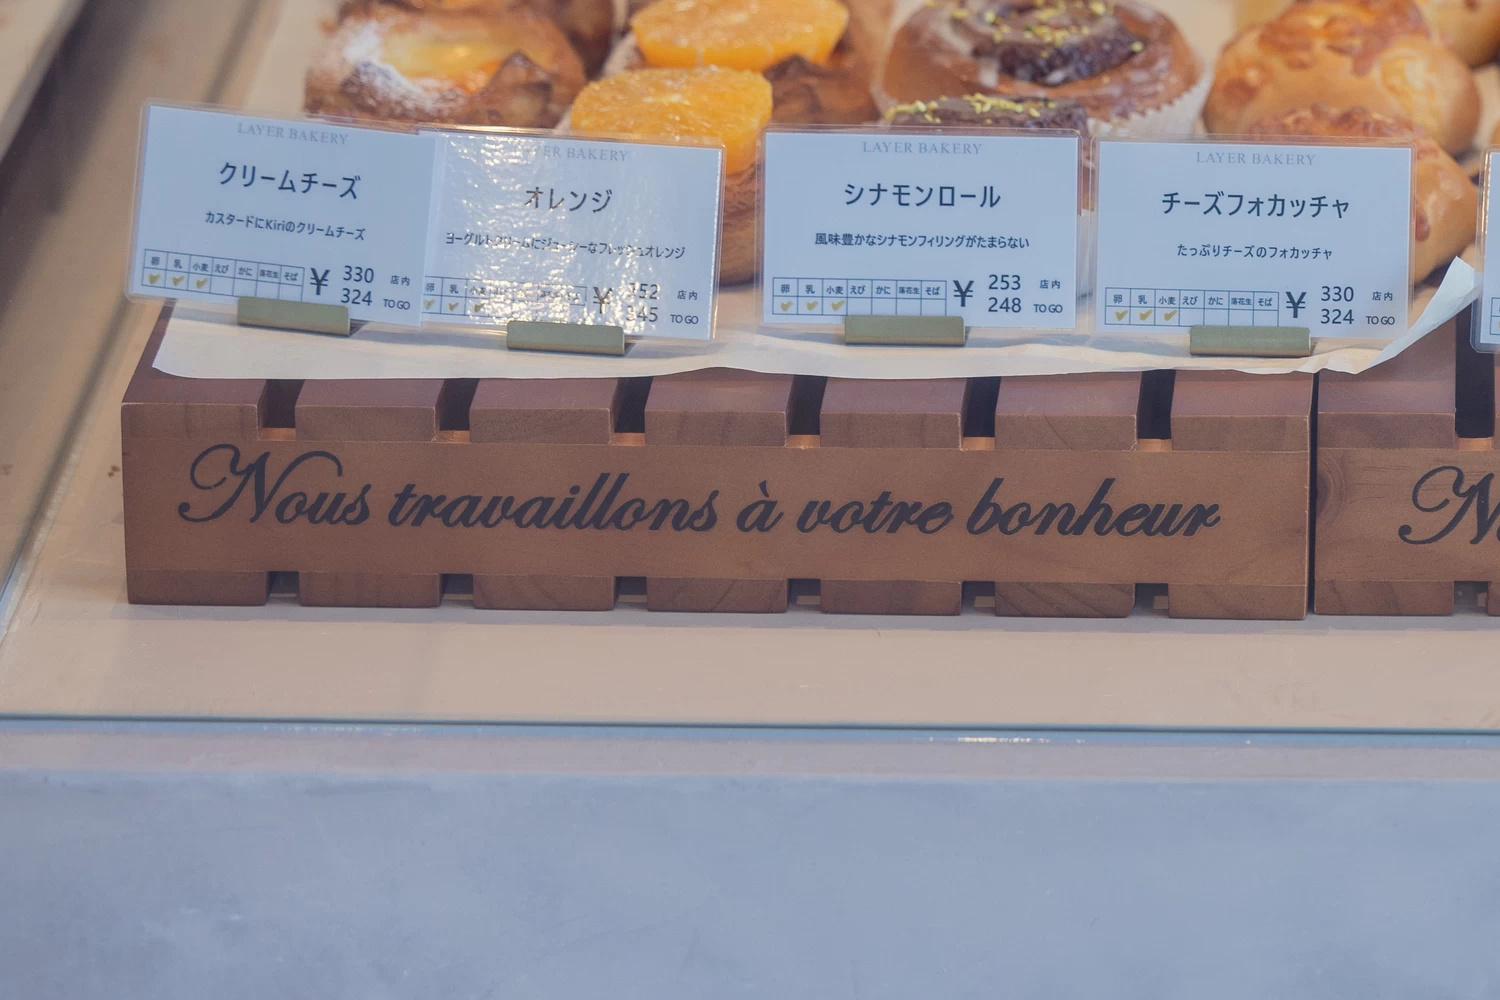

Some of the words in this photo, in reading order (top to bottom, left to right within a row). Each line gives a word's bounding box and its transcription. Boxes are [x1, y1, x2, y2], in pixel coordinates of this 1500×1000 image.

[237, 122, 285, 139] LAYER
[289, 128, 349, 146] BAKERY
[567, 147, 629, 161] BAKERY
[863, 141, 913, 154] LAYER
[918, 142, 983, 155] BAKERY
[1196, 152, 1246, 164] LAYER
[1252, 153, 1316, 166] BAKERY
[219, 161, 362, 200] クリームチーズ
[525, 186, 613, 213] オレンジ
[844, 182, 1001, 208] シナモンロール
[1162, 191, 1349, 219] チーズフォカッチャ
[205, 211, 366, 241] カスタードにKiriのクリームチーズ
[814, 232, 1030, 249] 風味豊かなシナモンフィリングがたまらない
[1177, 243, 1333, 261] たっぷりチーズのフォカッチャ
[342, 266, 375, 284] 330
[988, 274, 1021, 290] 253
[340, 288, 374, 307] 324
[1320, 286, 1355, 302] 330
[988, 297, 1021, 313] 248
[1320, 309, 1355, 325] 324
[178, 443, 370, 525] Nous
[388, 472, 718, 532] travaillons
[736, 480, 784, 534] à
[796, 490, 954, 534] votre
[966, 477, 1221, 537] bonheur
